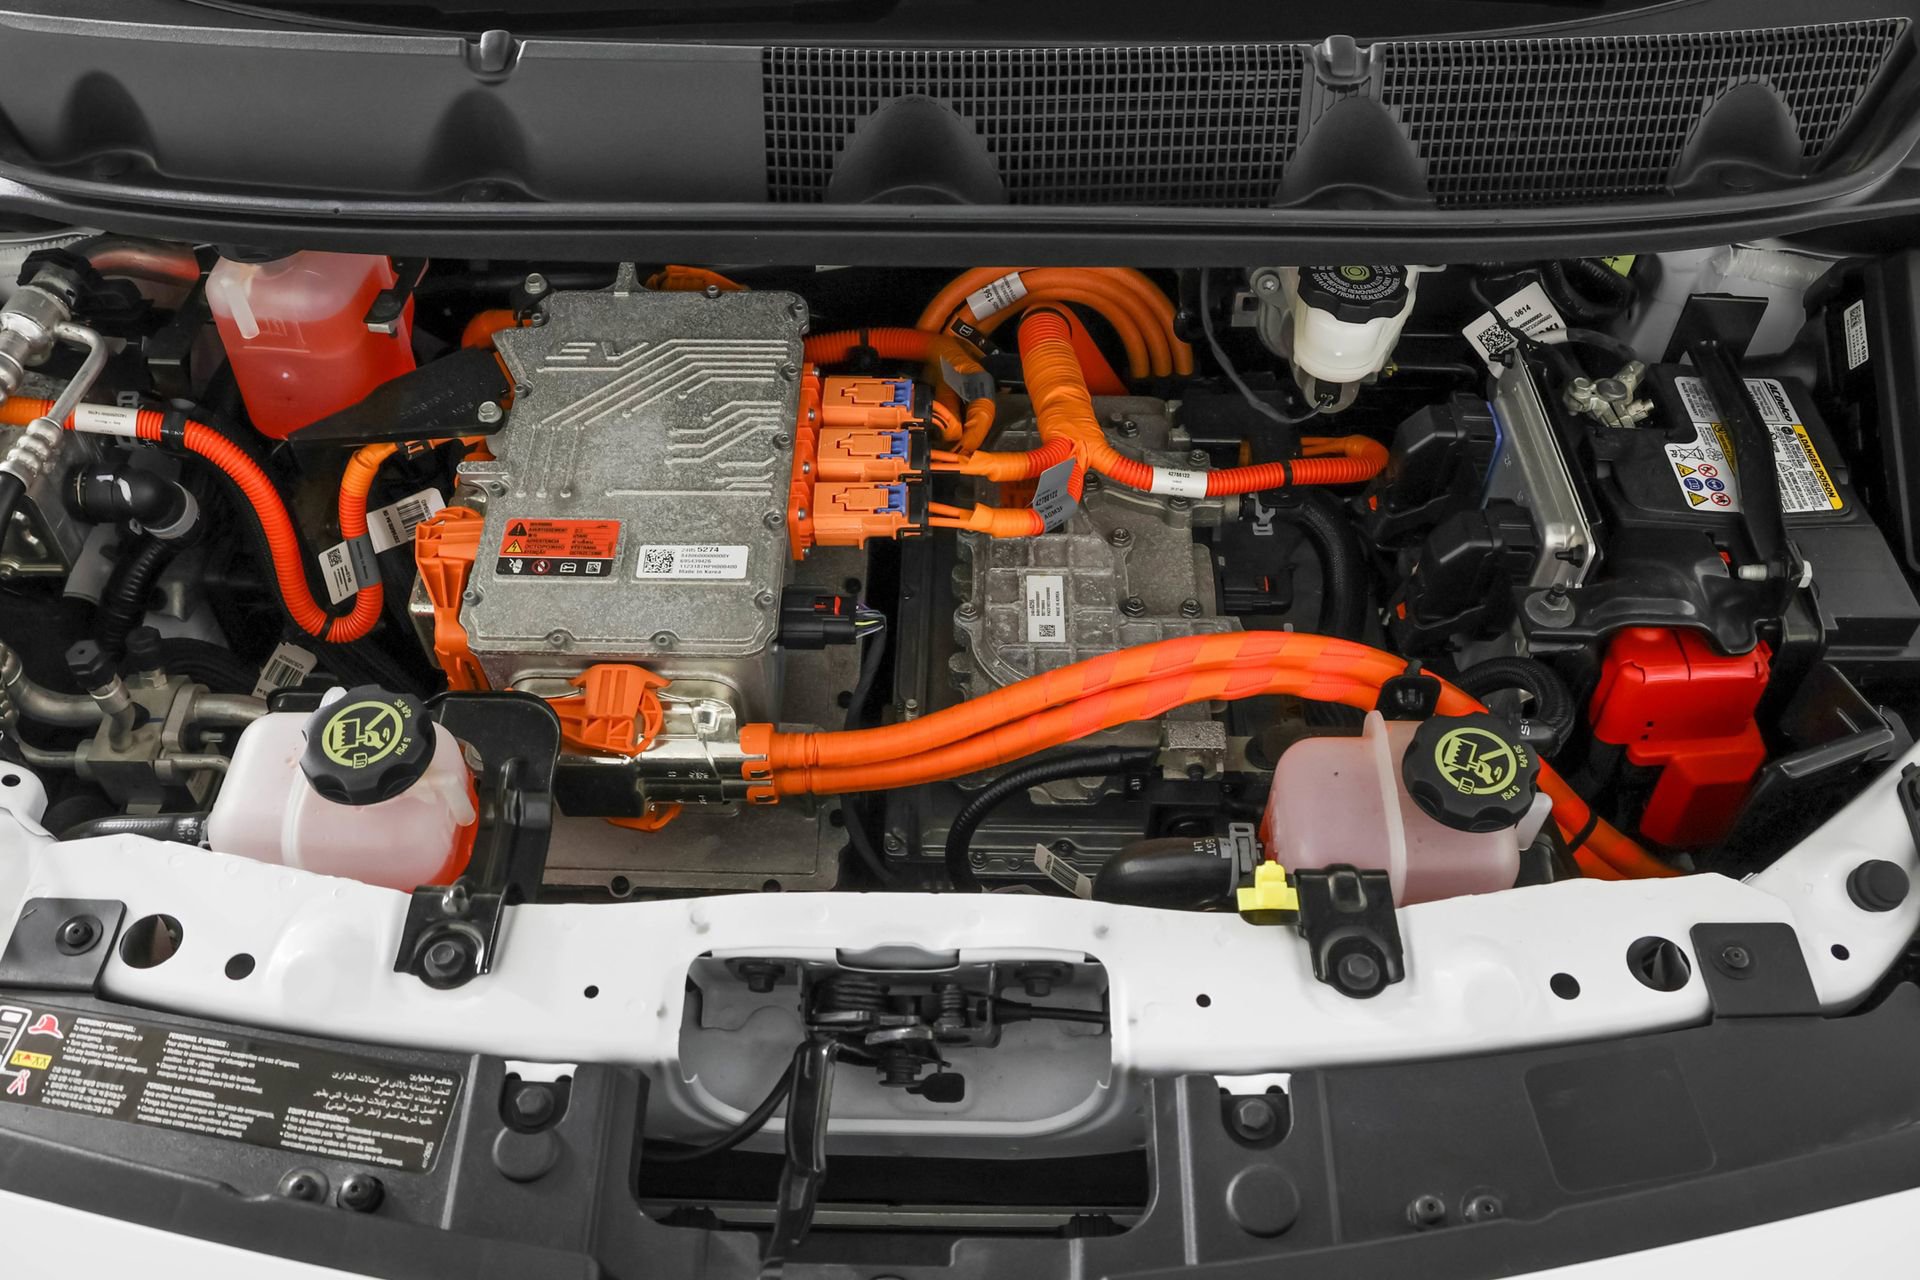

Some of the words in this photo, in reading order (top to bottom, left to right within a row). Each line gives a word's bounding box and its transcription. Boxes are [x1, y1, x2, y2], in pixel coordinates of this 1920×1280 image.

[1514, 304, 1531, 318] 0614
[1767, 382, 1792, 422] ACDelco
[393, 698, 403, 708] 35
[402, 704, 412, 719] kPa
[403, 736, 412, 744] 5
[395, 742, 409, 756] PSI
[1513, 744, 1521, 754] 35
[1519, 752, 1528, 768] kPa
[1502, 789, 1517, 801] PSI
[1512, 785, 1521, 793] 5
